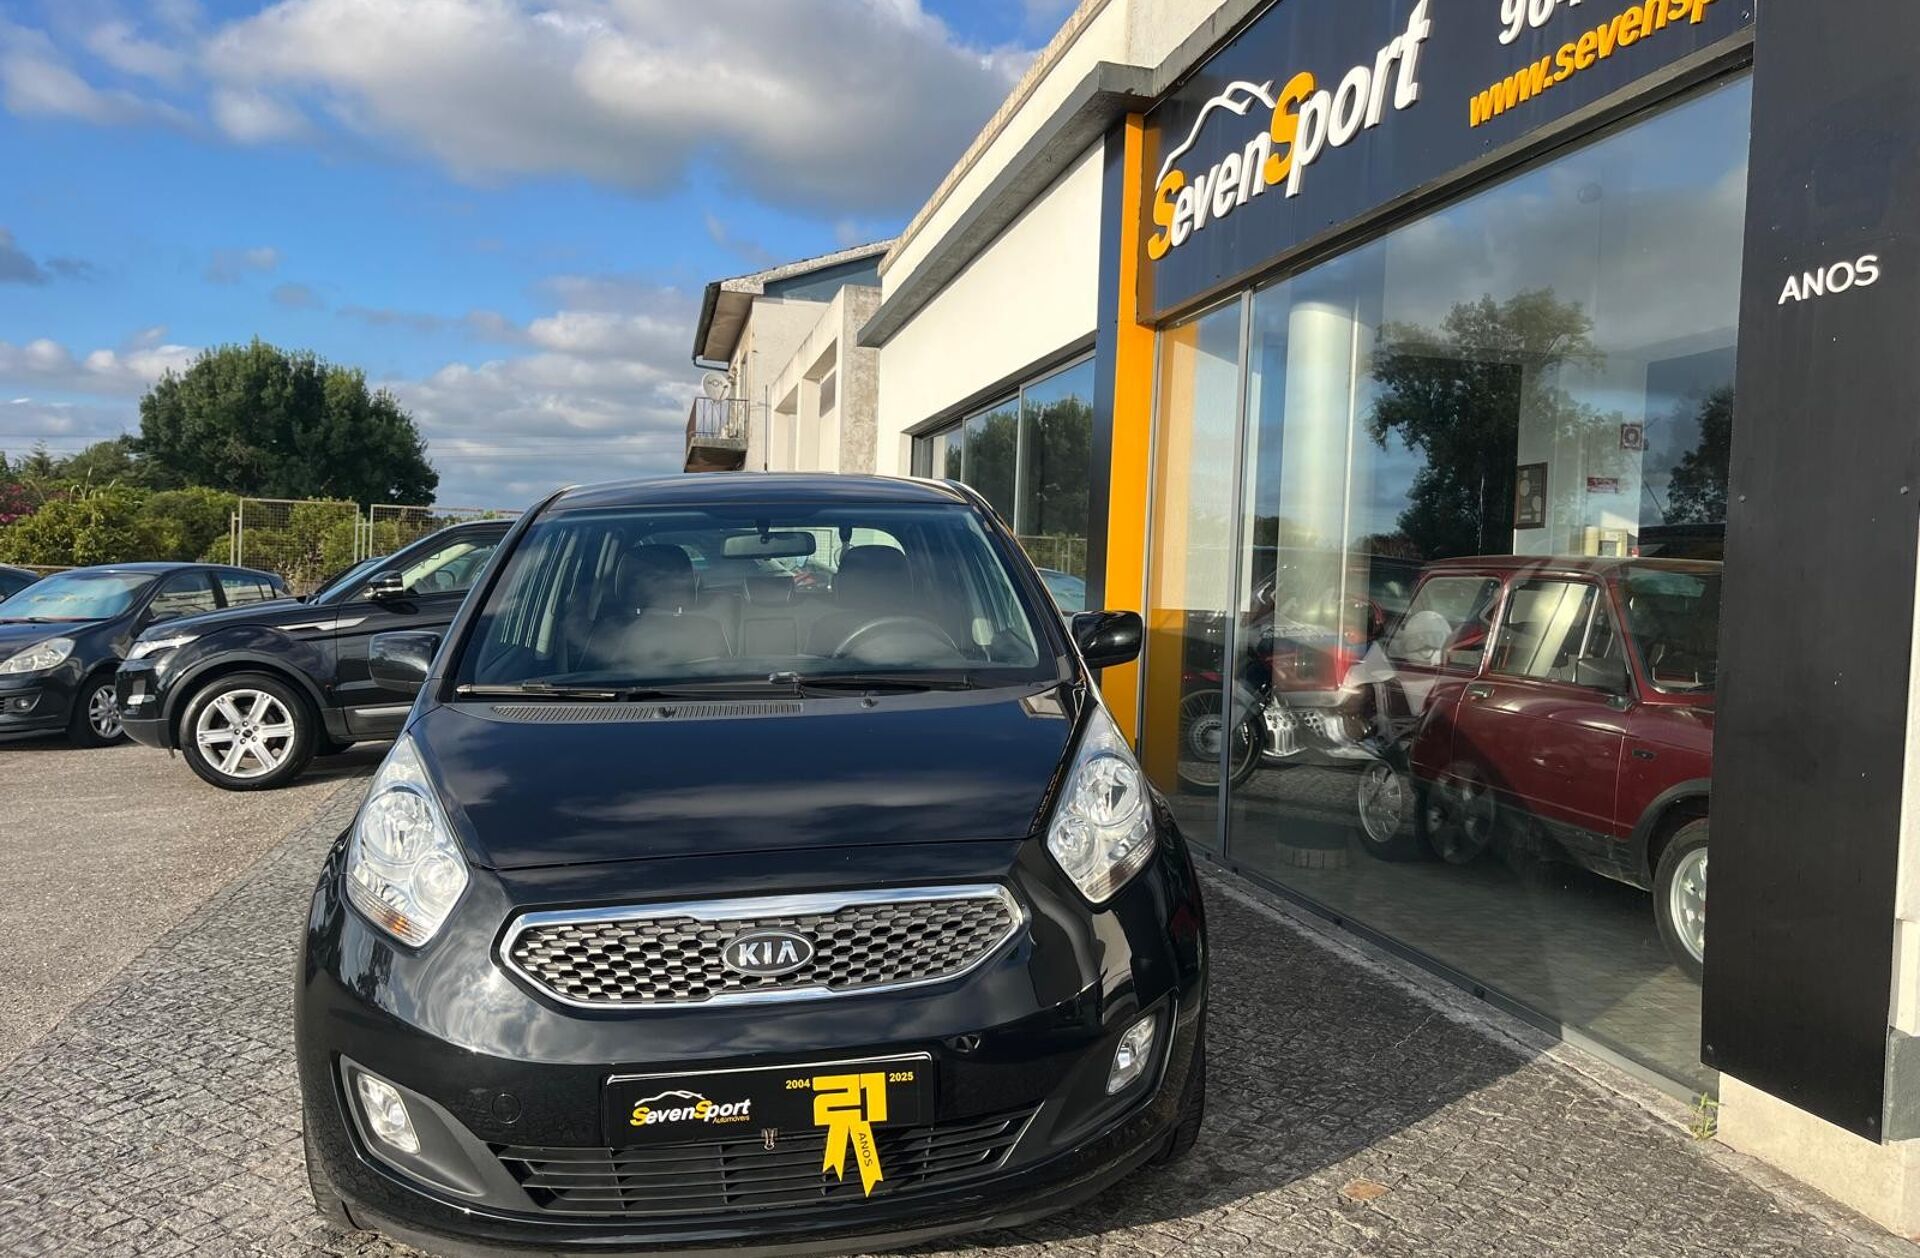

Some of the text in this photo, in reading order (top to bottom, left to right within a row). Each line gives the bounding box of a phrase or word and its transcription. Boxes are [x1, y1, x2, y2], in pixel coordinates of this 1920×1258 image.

[1148, 0, 1431, 260] SevenSport
[1778, 254, 1880, 305] ANOS
[738, 940, 799, 967] KIA
[786, 1079, 811, 1089] 2004
[889, 1072, 914, 1082] 2025
[630, 1099, 751, 1126] SevenSport
[813, 1072, 888, 1126] 21
[858, 1132, 873, 1167] ANOS
